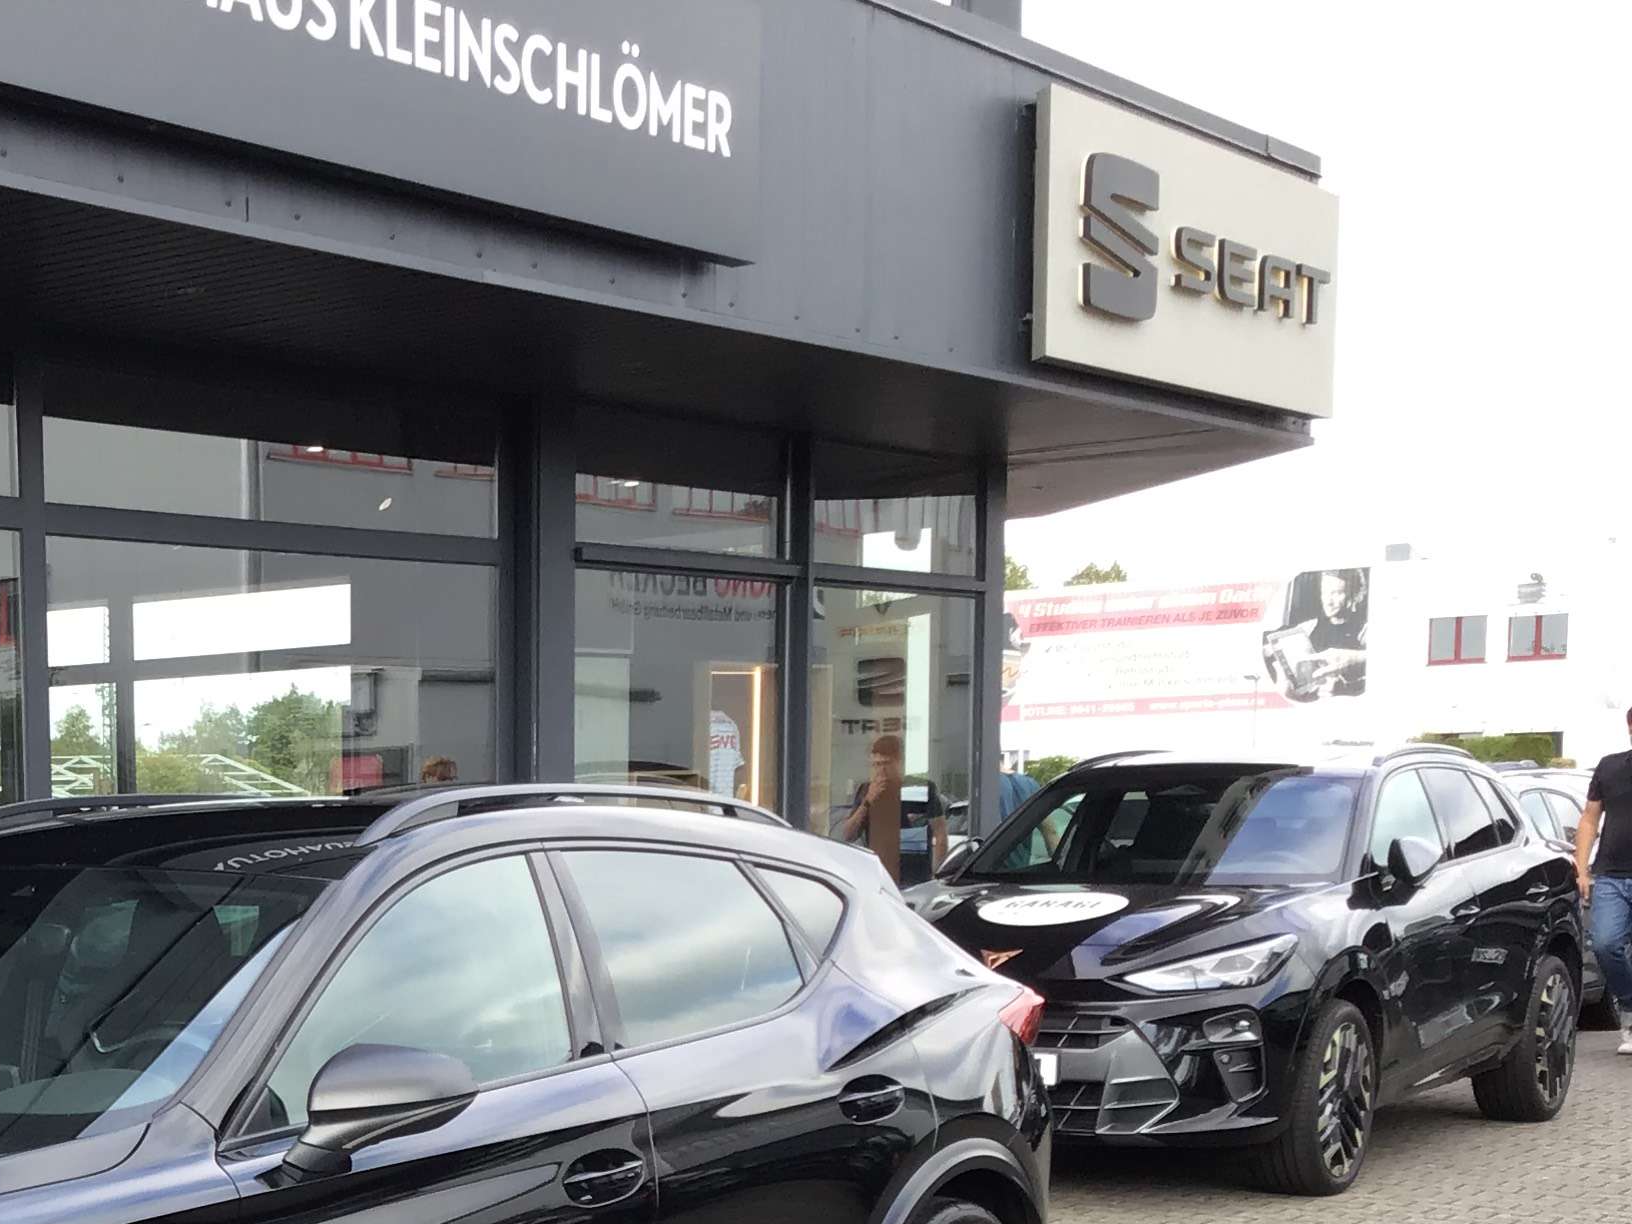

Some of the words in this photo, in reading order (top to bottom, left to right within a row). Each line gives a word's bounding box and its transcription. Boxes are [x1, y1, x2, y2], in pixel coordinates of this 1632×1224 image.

[349, 0, 732, 157] KLEINSCHLÖMER
[1170, 225, 1331, 326] SEAT
[1029, 618, 1097, 633] EFFEKTIVER
[1100, 614, 1173, 629] TRAINIEREN
[1172, 611, 1196, 624] ALS
[1198, 610, 1213, 622] JE
[1215, 608, 1259, 621] ZUVOR
